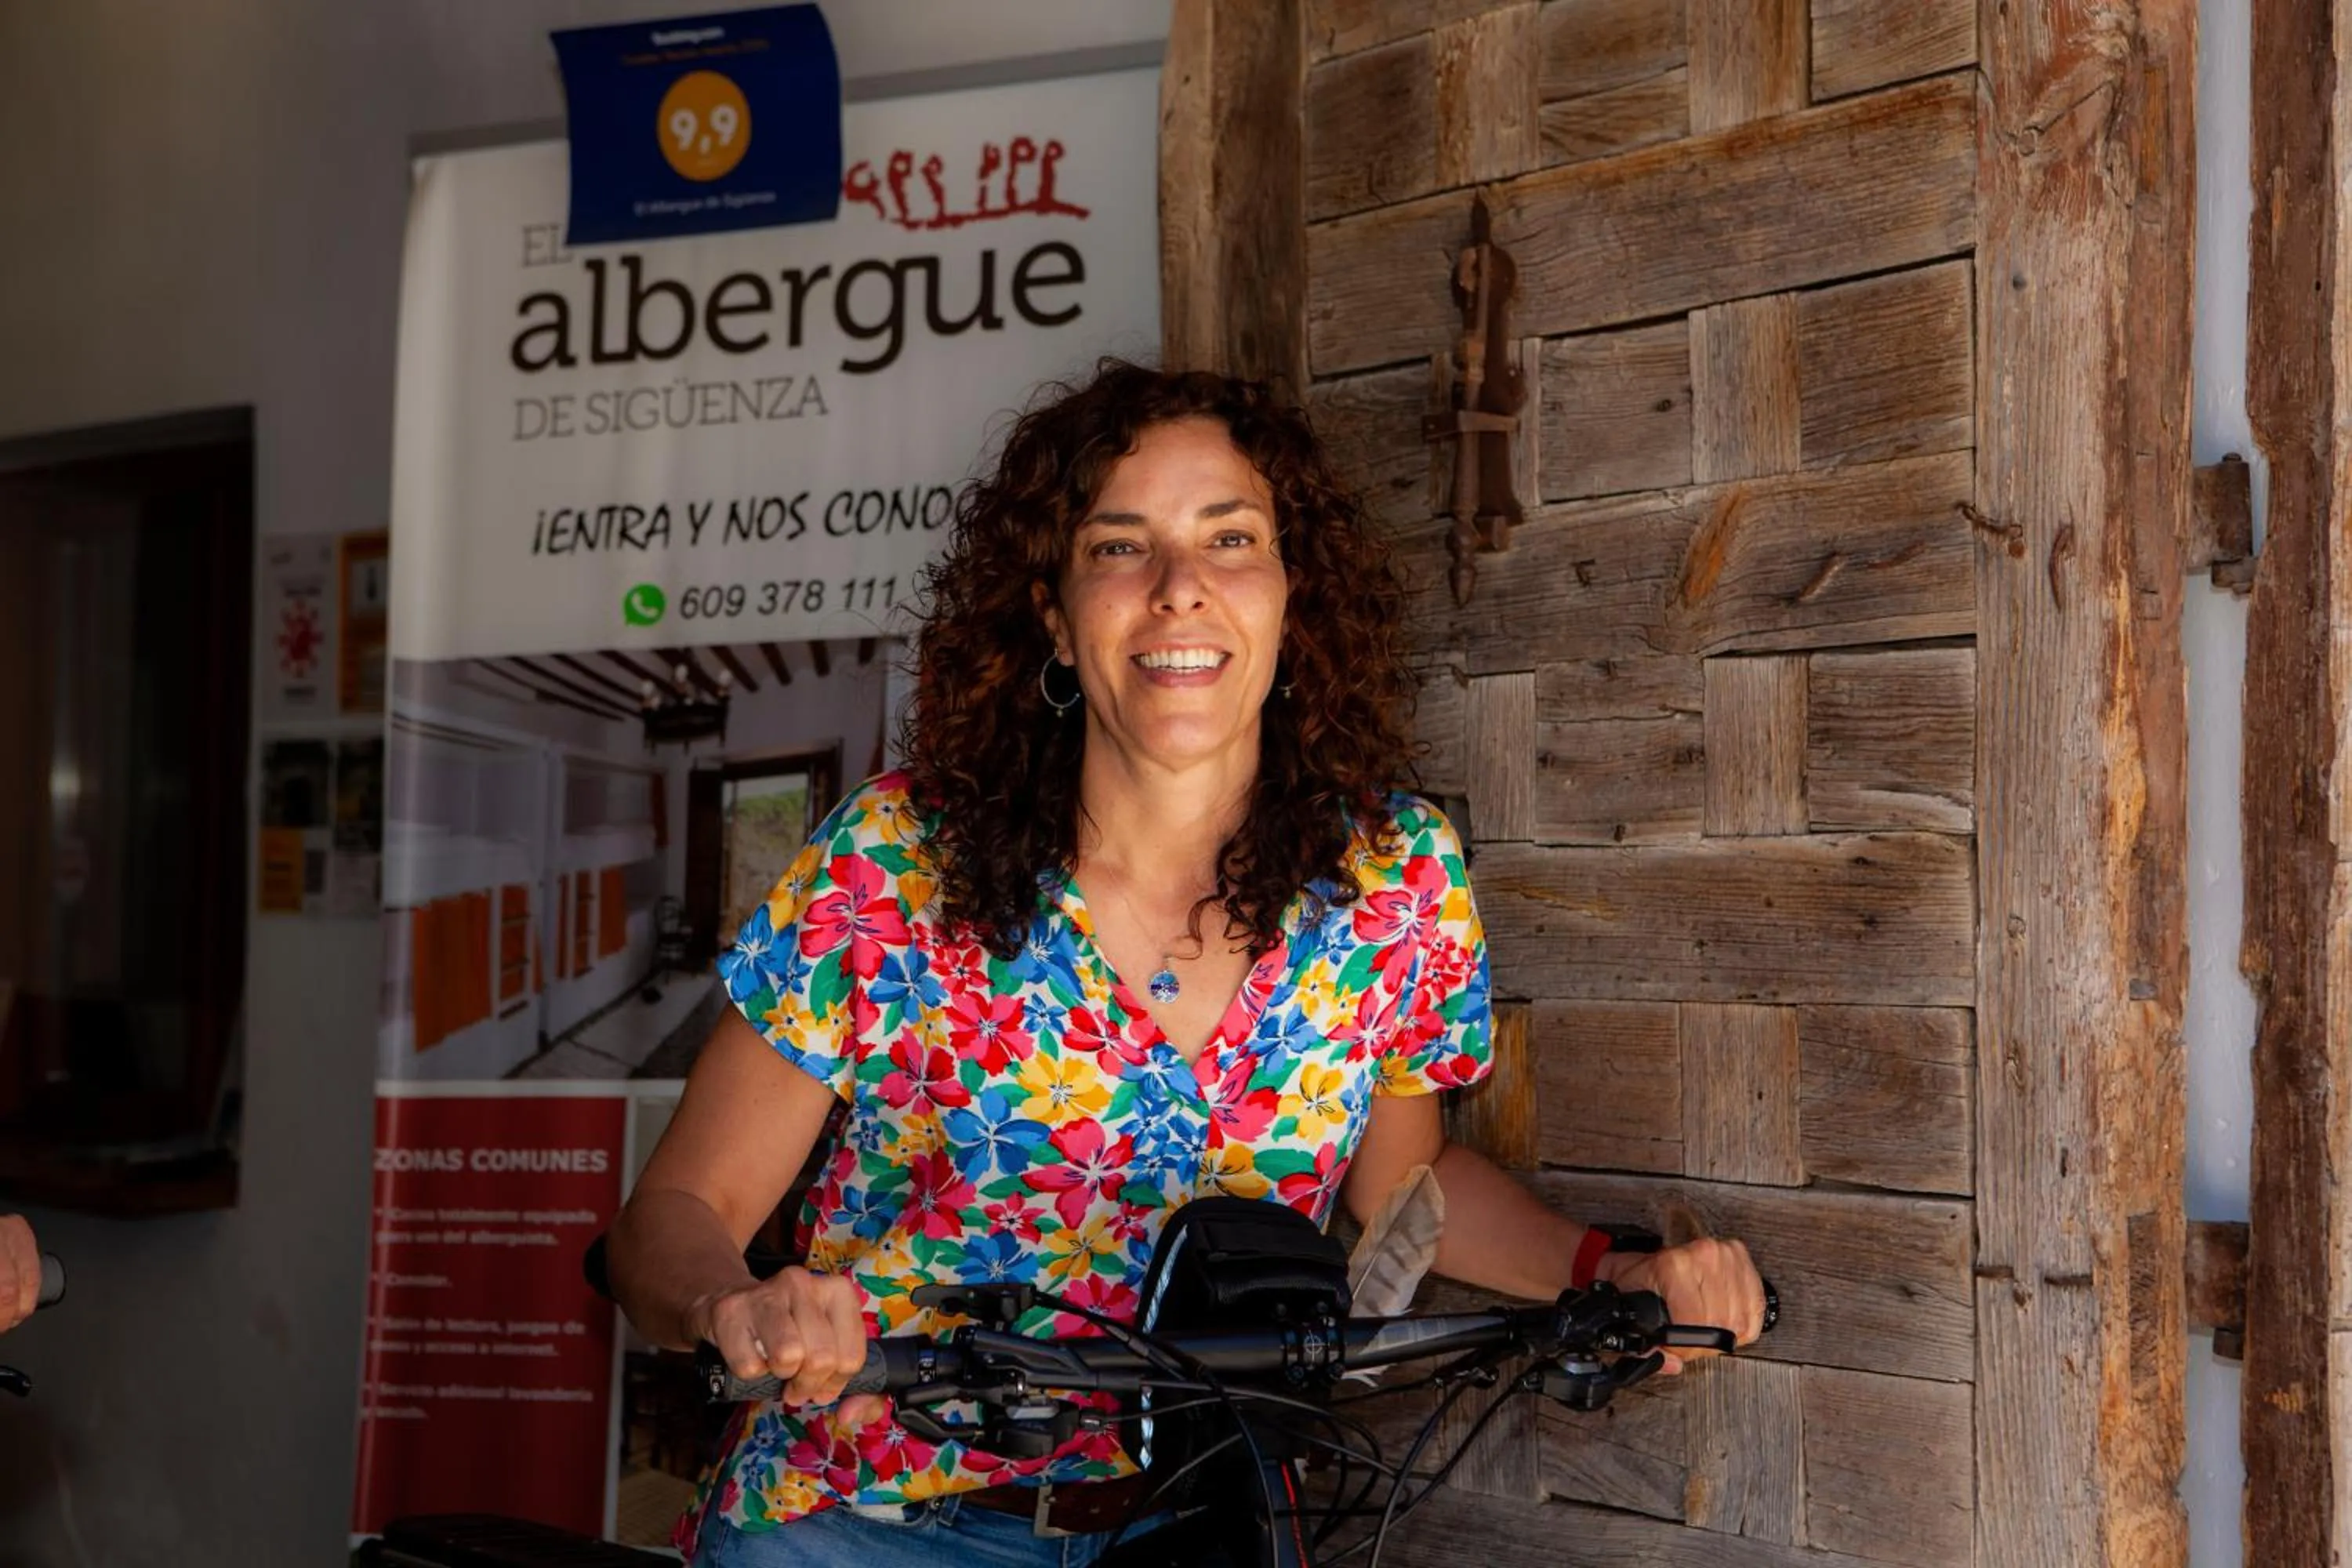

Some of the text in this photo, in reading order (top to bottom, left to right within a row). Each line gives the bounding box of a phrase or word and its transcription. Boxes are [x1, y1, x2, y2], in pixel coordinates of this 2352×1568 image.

[670, 103, 739, 154] 9,9
[521, 221, 575, 269] EL
[510, 241, 1086, 376] albergue
[514, 374, 829, 441] DE SIGÜENZA
[687, 501, 713, 546] Y
[723, 492, 810, 544] NOS
[823, 485, 953, 538] CONO
[679, 575, 897, 620] 609 378 111
[374, 1148, 608, 1173] ZONAS COMUNES
